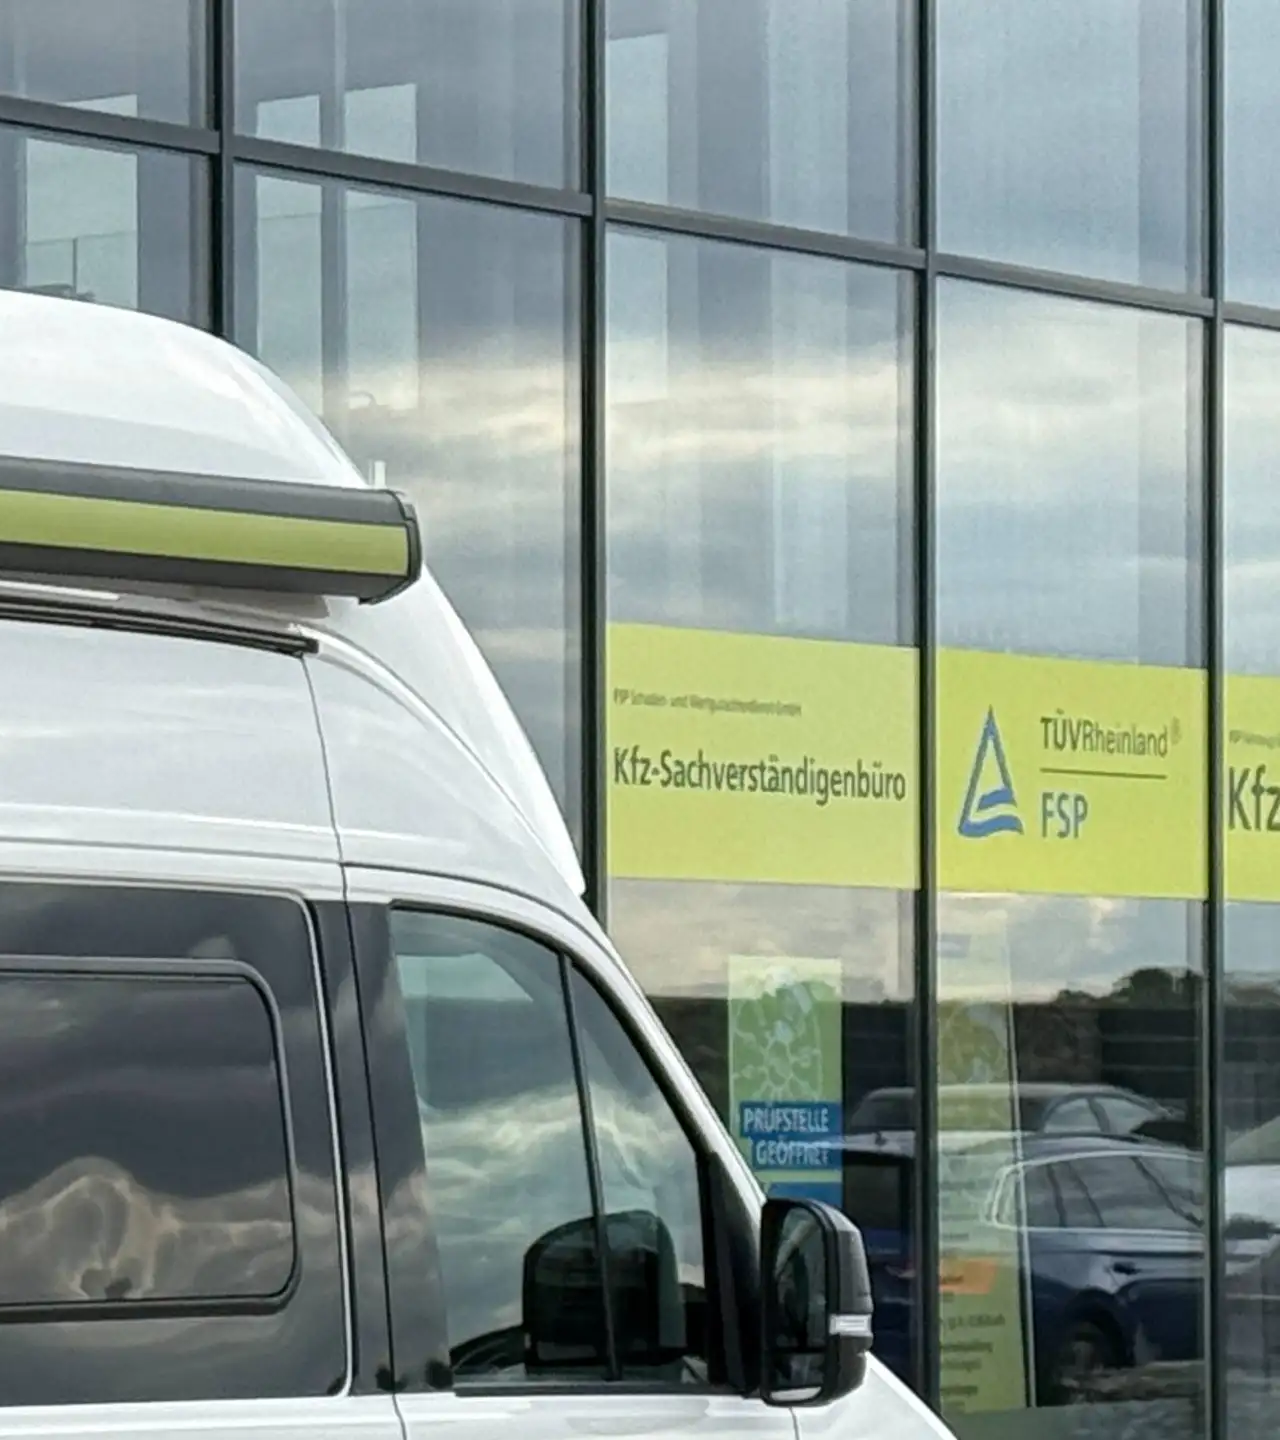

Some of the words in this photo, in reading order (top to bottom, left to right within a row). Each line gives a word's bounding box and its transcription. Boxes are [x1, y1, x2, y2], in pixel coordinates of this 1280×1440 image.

[613, 745, 906, 806] Kfz-Sachverständigenbüro
[1041, 792, 1089, 839] FSP
[743, 1103, 829, 1132] PRÜFSTELLE
